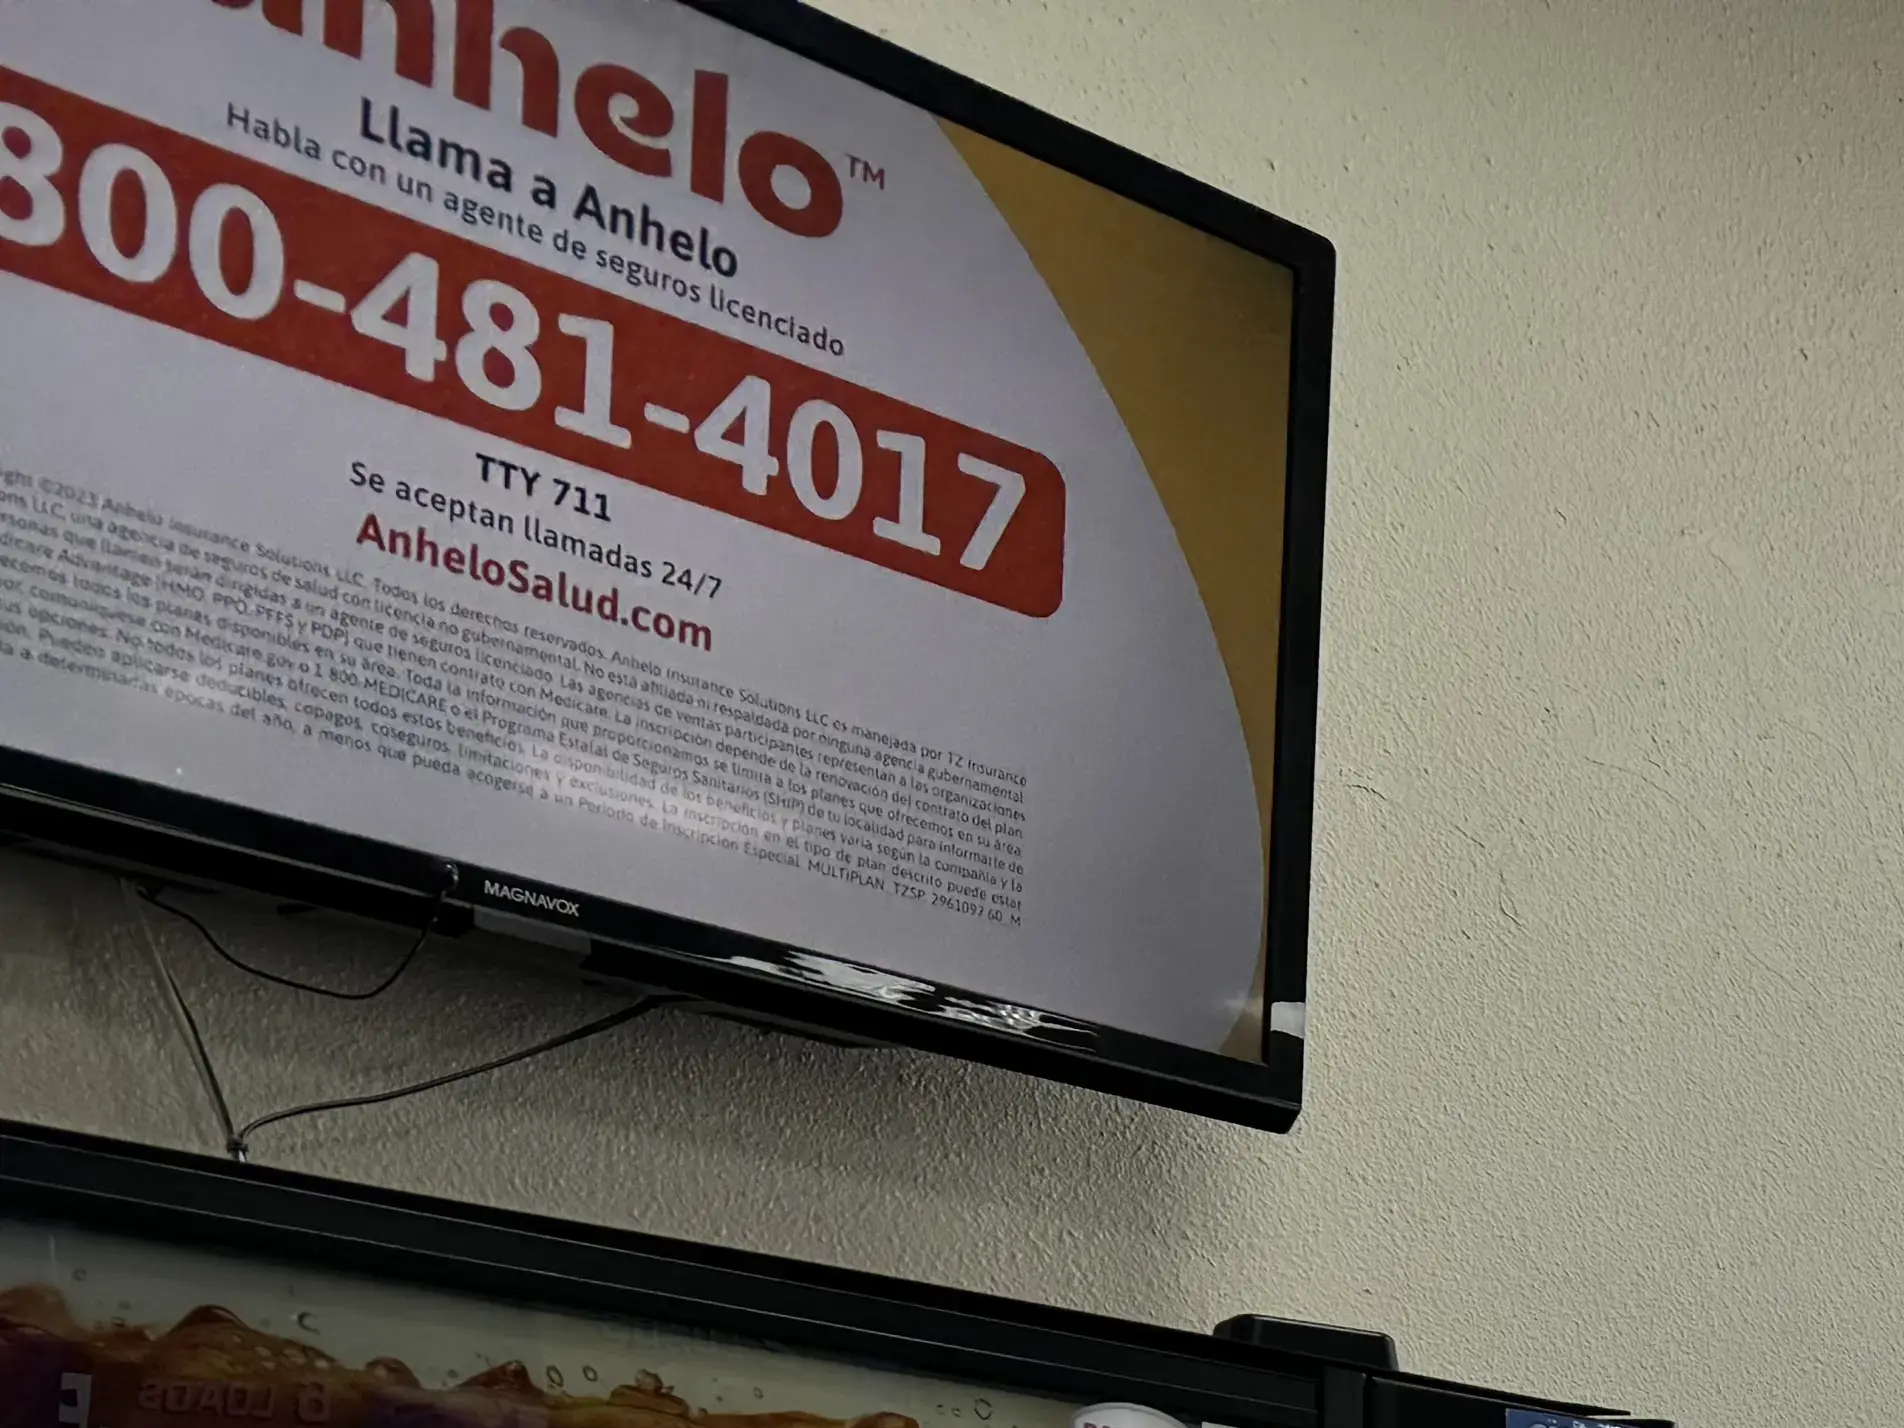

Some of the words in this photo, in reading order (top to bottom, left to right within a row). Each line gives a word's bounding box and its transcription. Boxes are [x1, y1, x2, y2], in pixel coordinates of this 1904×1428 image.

[212, 0, 843, 238] nhelo
[360, 96, 511, 192] Llama
[532, 176, 557, 209] a
[574, 184, 738, 278] Anhelo
[227, 102, 321, 160] Habla
[333, 150, 386, 184] con
[397, 175, 433, 203] un
[444, 191, 542, 243] agente
[552, 231, 587, 260] de
[596, 247, 701, 302] seguros
[710, 285, 844, 356] licenciado
[350, 461, 384, 493] Se
[396, 480, 513, 534] aceptan
[524, 514, 652, 578] llamadas
[661, 561, 722, 599] 24/7
[475, 452, 539, 496] TTY
[552, 478, 612, 522] 711
[356, 513, 712, 651] AnheloSalud.com
[484, 880, 580, 917] MAGNAVOX
